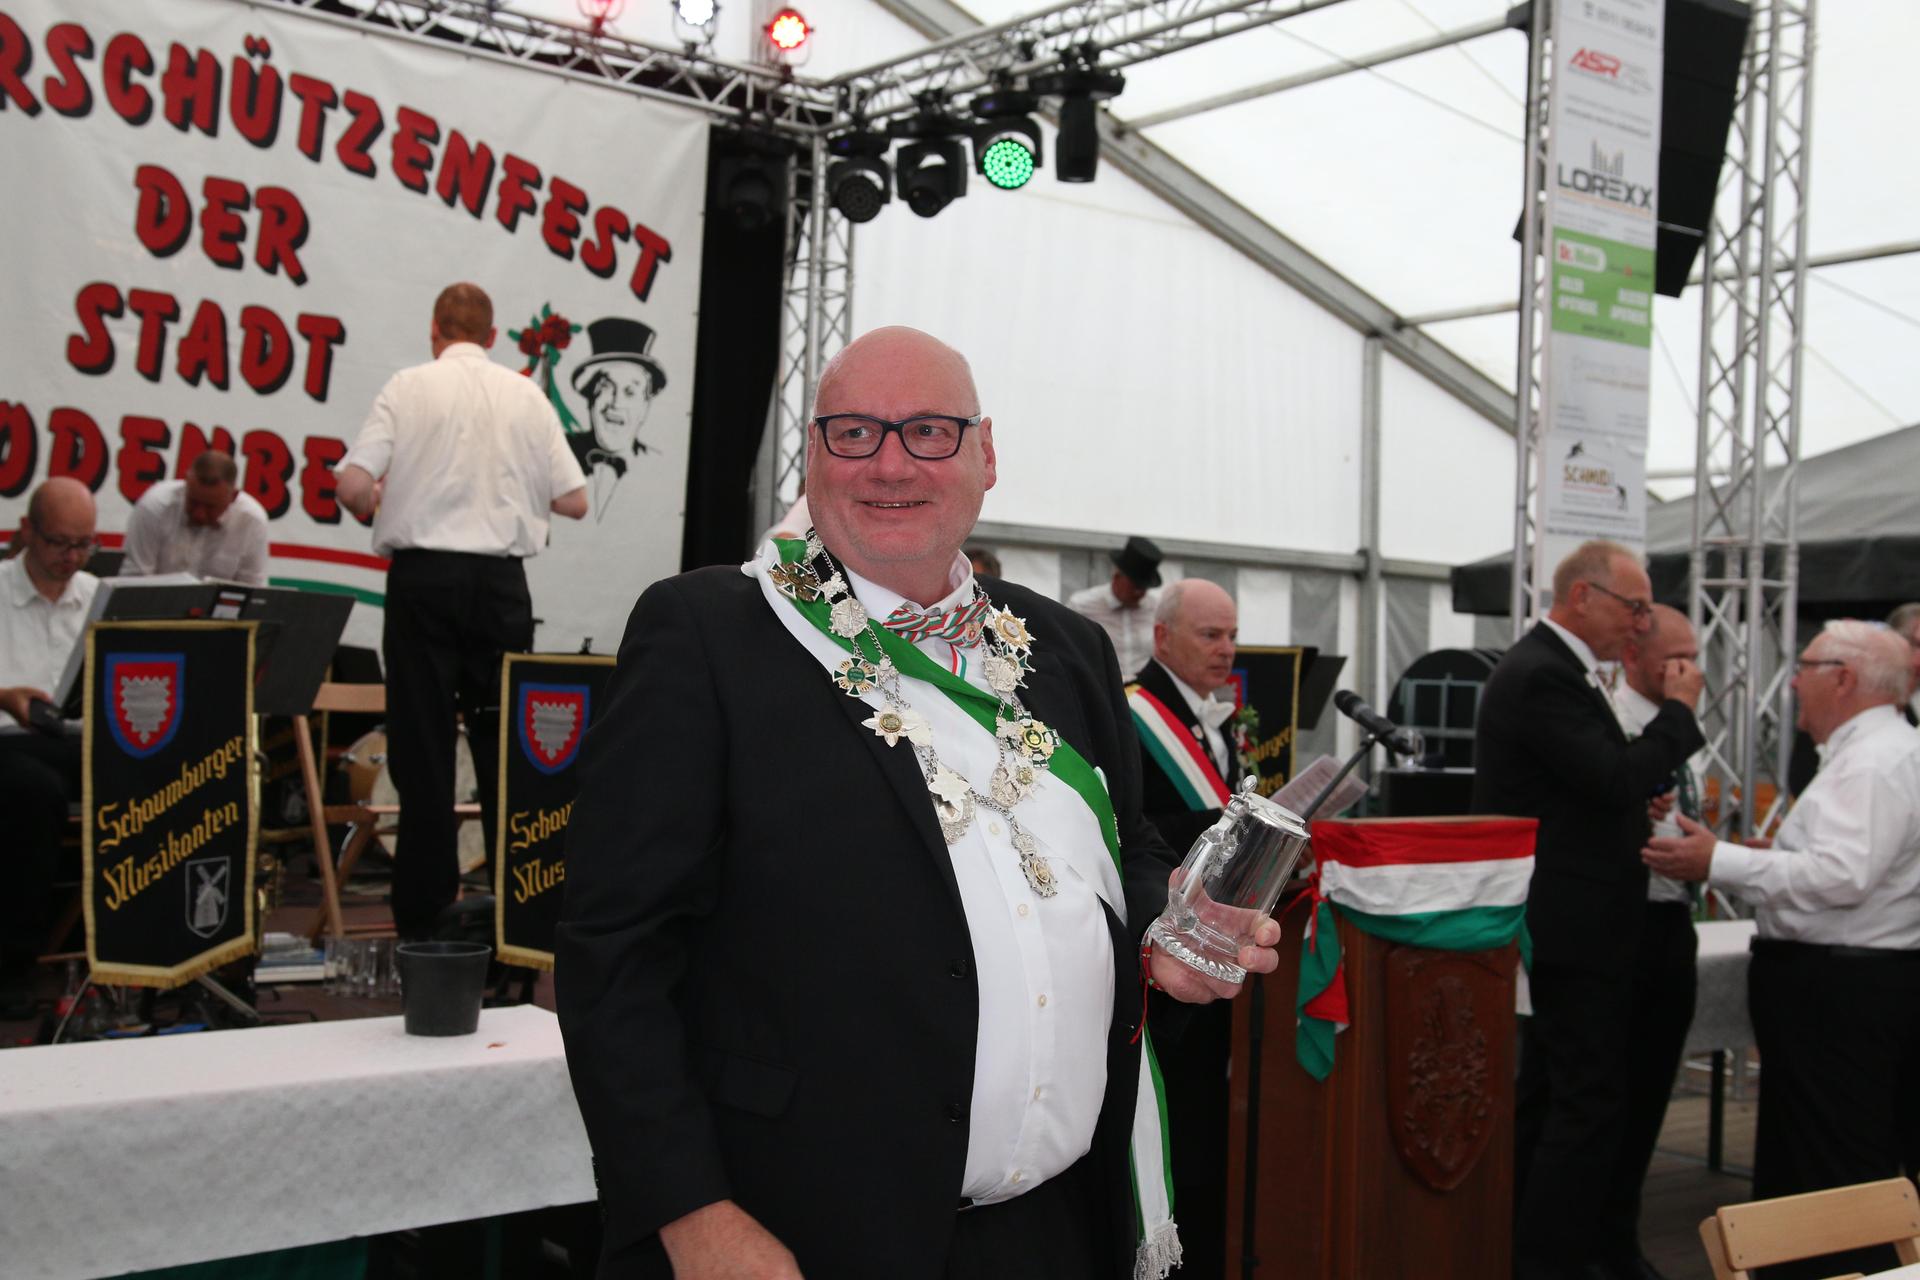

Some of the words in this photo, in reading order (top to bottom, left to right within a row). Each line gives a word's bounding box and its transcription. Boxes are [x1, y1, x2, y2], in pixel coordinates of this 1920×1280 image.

[1568, 47, 1622, 79] ASR
[134, 164, 309, 286] DER
[1557, 162, 1652, 210] LOREXX
[66, 281, 346, 402] STADT
[98, 735, 244, 854] Schaumburger
[103, 800, 240, 912] Musikanten
